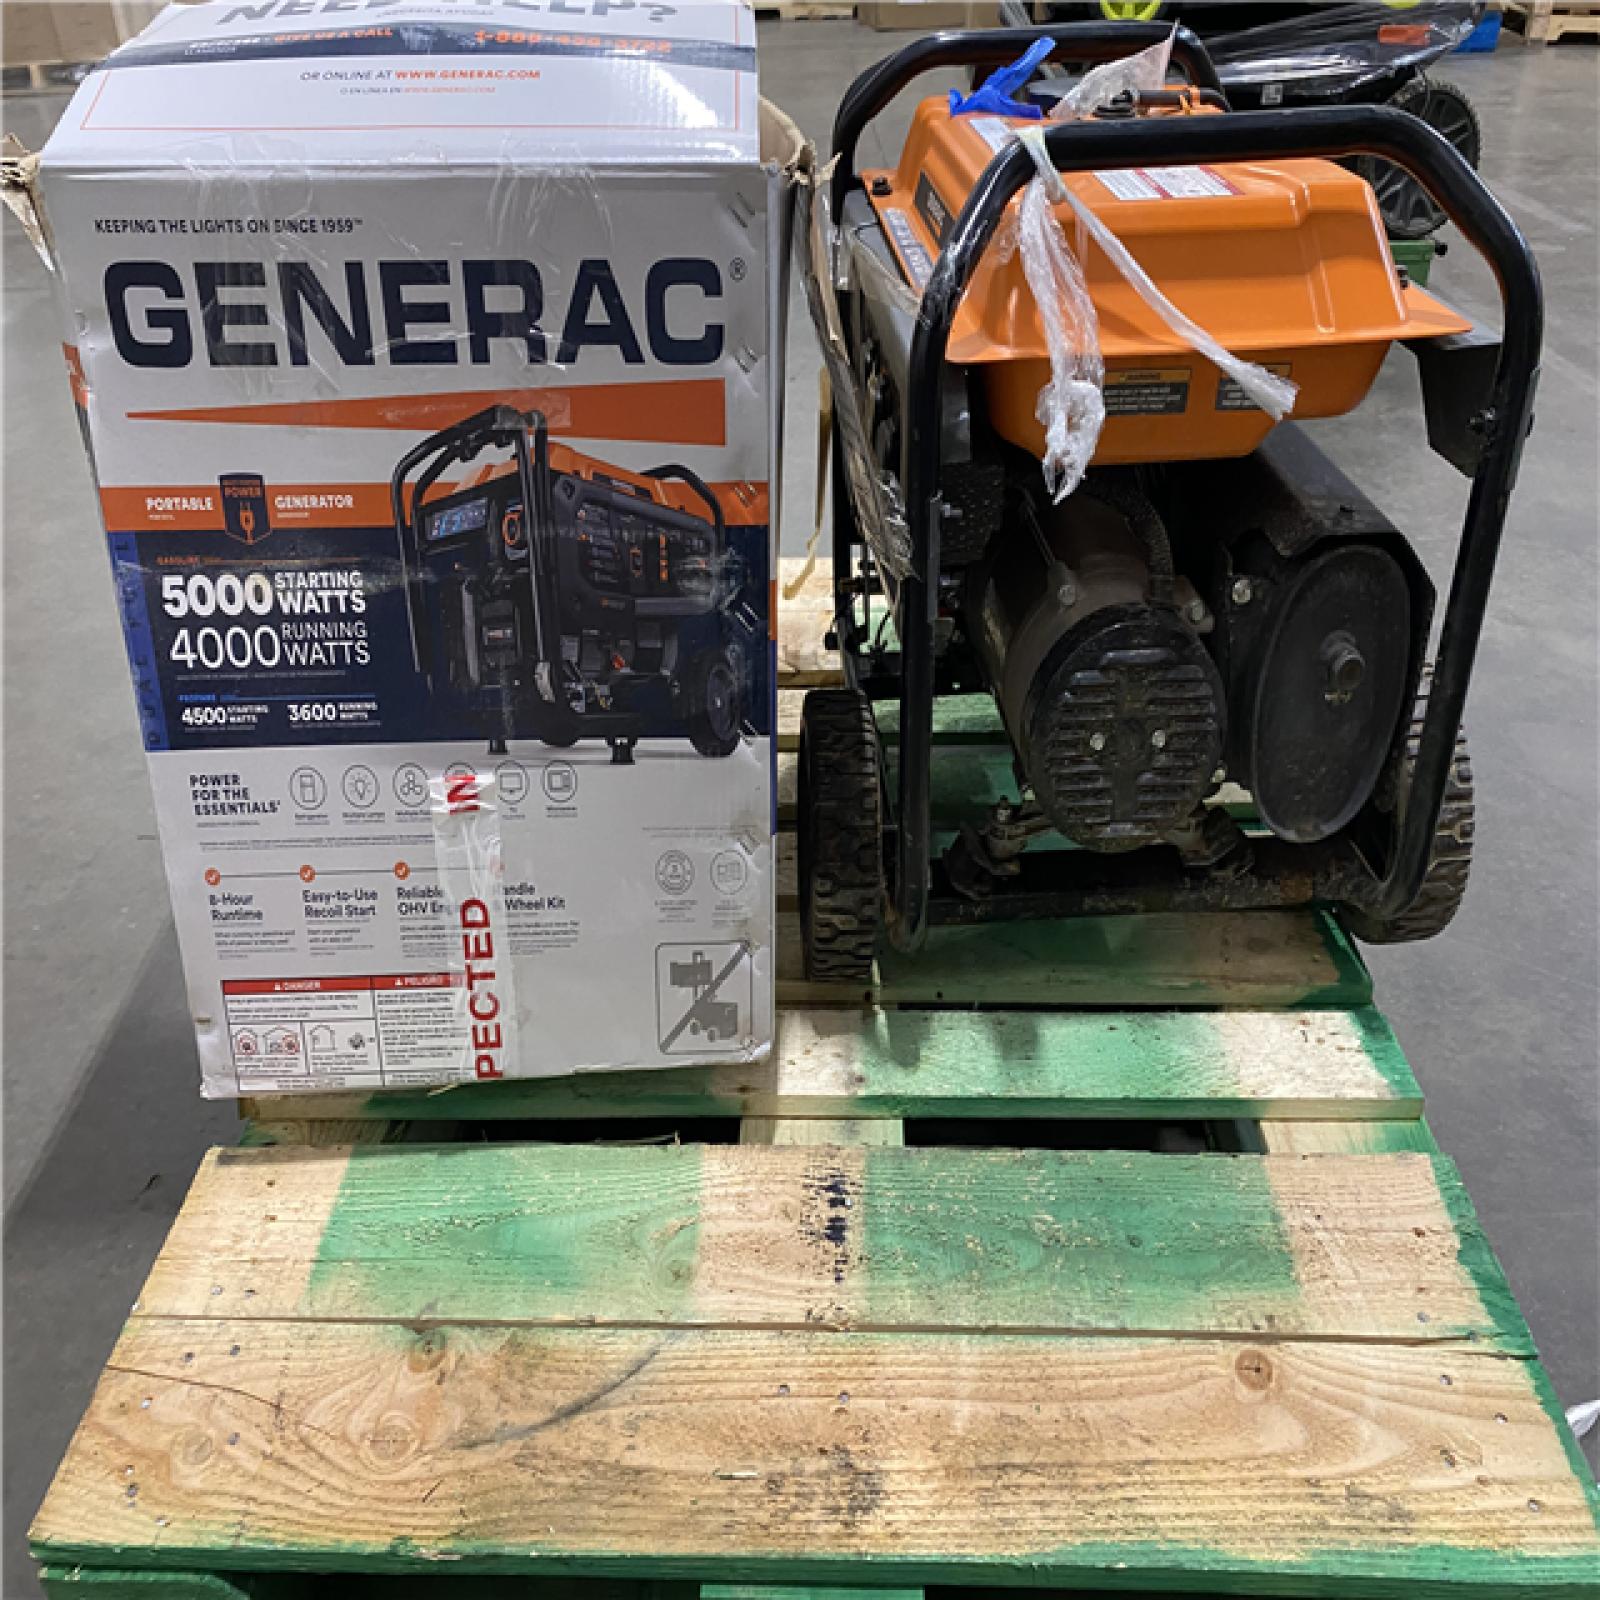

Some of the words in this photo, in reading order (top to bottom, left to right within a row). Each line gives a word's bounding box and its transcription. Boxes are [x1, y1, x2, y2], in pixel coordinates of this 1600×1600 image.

[300, 71, 321, 80] OR
[322, 71, 373, 80] ONLINE
[375, 70, 393, 80] AT
[395, 69, 541, 80] WWW.GENERAC.COM
[94, 219, 156, 233] KEEPING
[159, 219, 188, 233] THE
[191, 219, 244, 233] LIGHTS
[247, 219, 270, 233] ON
[274, 219, 317, 233] SINCE
[145, 496, 213, 511] PORTABLE
[274, 494, 354, 508] GENERATOR
[274, 570, 365, 589] STARTING
[161, 573, 274, 618] 5000
[277, 588, 367, 615] WATTS
[282, 621, 368, 639] RUNNING
[169, 625, 281, 669] 4000
[283, 639, 371, 666] WATTS
[181, 706, 227, 726] 4500
[288, 703, 337, 722] 3600
[190, 774, 240, 787] POWER
[192, 789, 220, 801] FOR
[222, 787, 249, 801] THE
[209, 892, 253, 906] 8-Hour
[302, 887, 378, 905] Easy-to-Use
[504, 897, 544, 911] Wheel
[547, 896, 566, 909] Kit
[211, 908, 263, 921] Runtime
[305, 904, 343, 918] Recoil
[344, 904, 377, 917] Start
[397, 901, 428, 915] OHV
